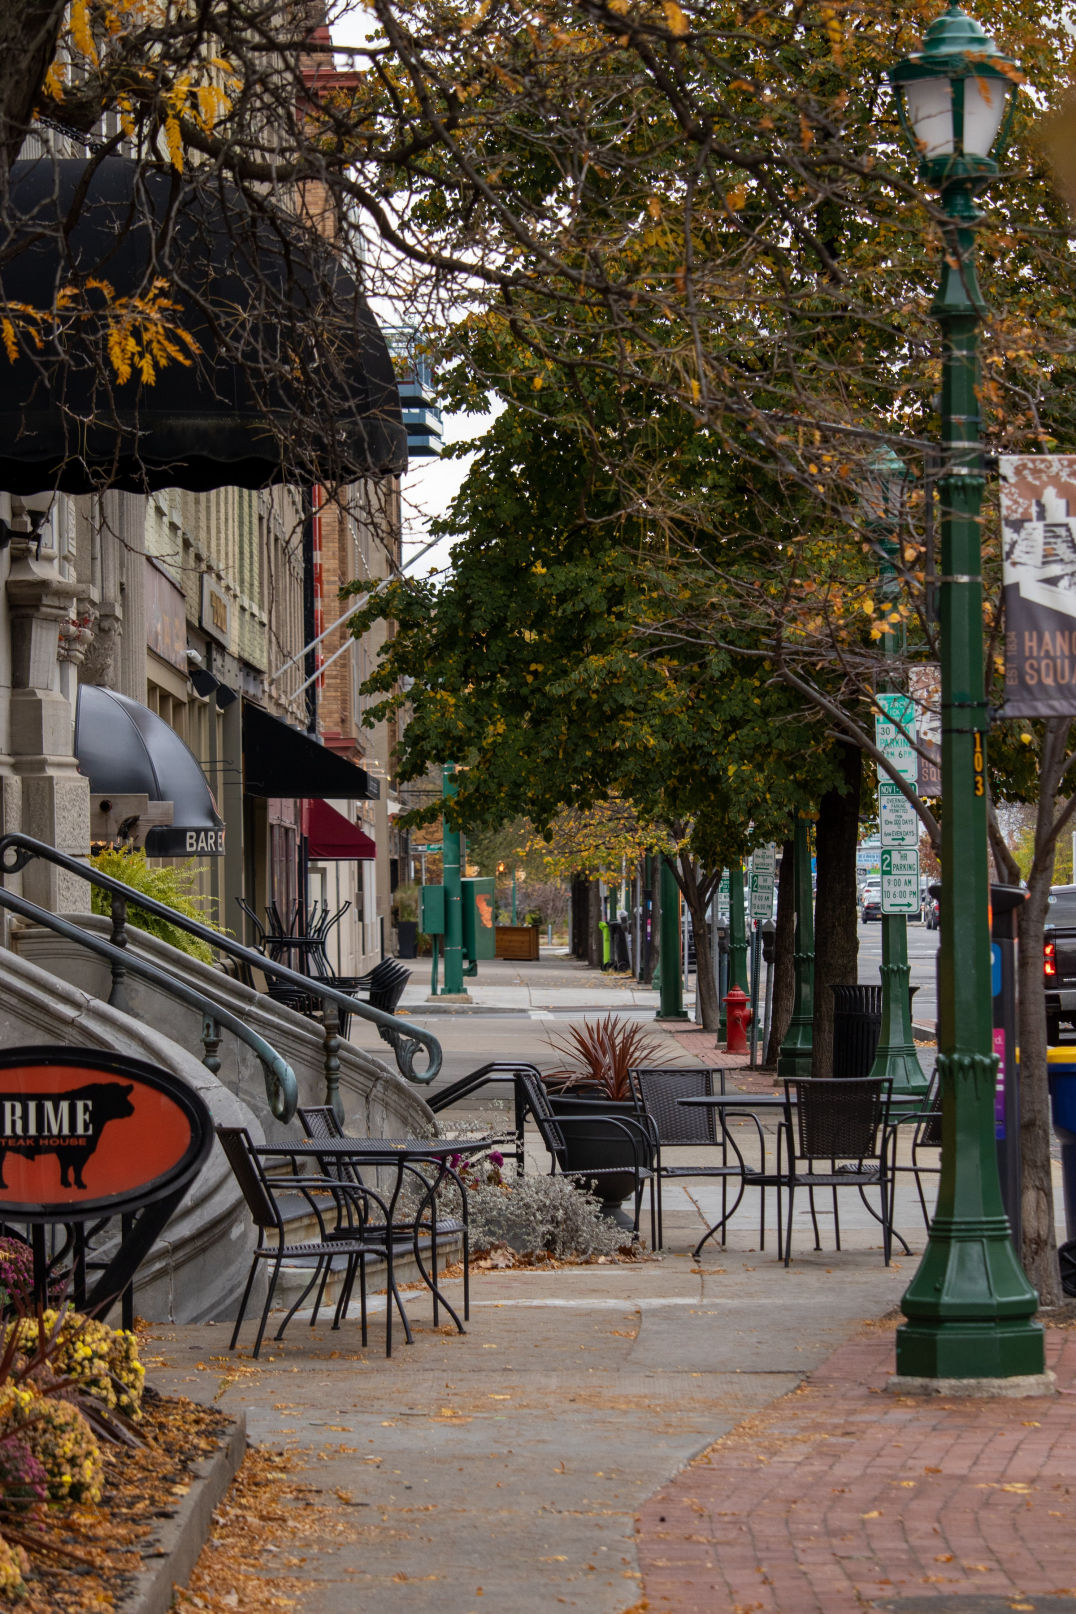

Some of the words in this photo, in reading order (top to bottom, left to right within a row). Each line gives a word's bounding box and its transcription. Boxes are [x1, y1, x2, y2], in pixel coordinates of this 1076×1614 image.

[880, 727, 891, 736] 30
[880, 739, 911, 748] PARKIN
[973, 732, 984, 796] 103
[882, 855, 890, 870] 2
[3, 1100, 93, 1136] RIME
[40, 1138, 87, 1146] HOUSE
